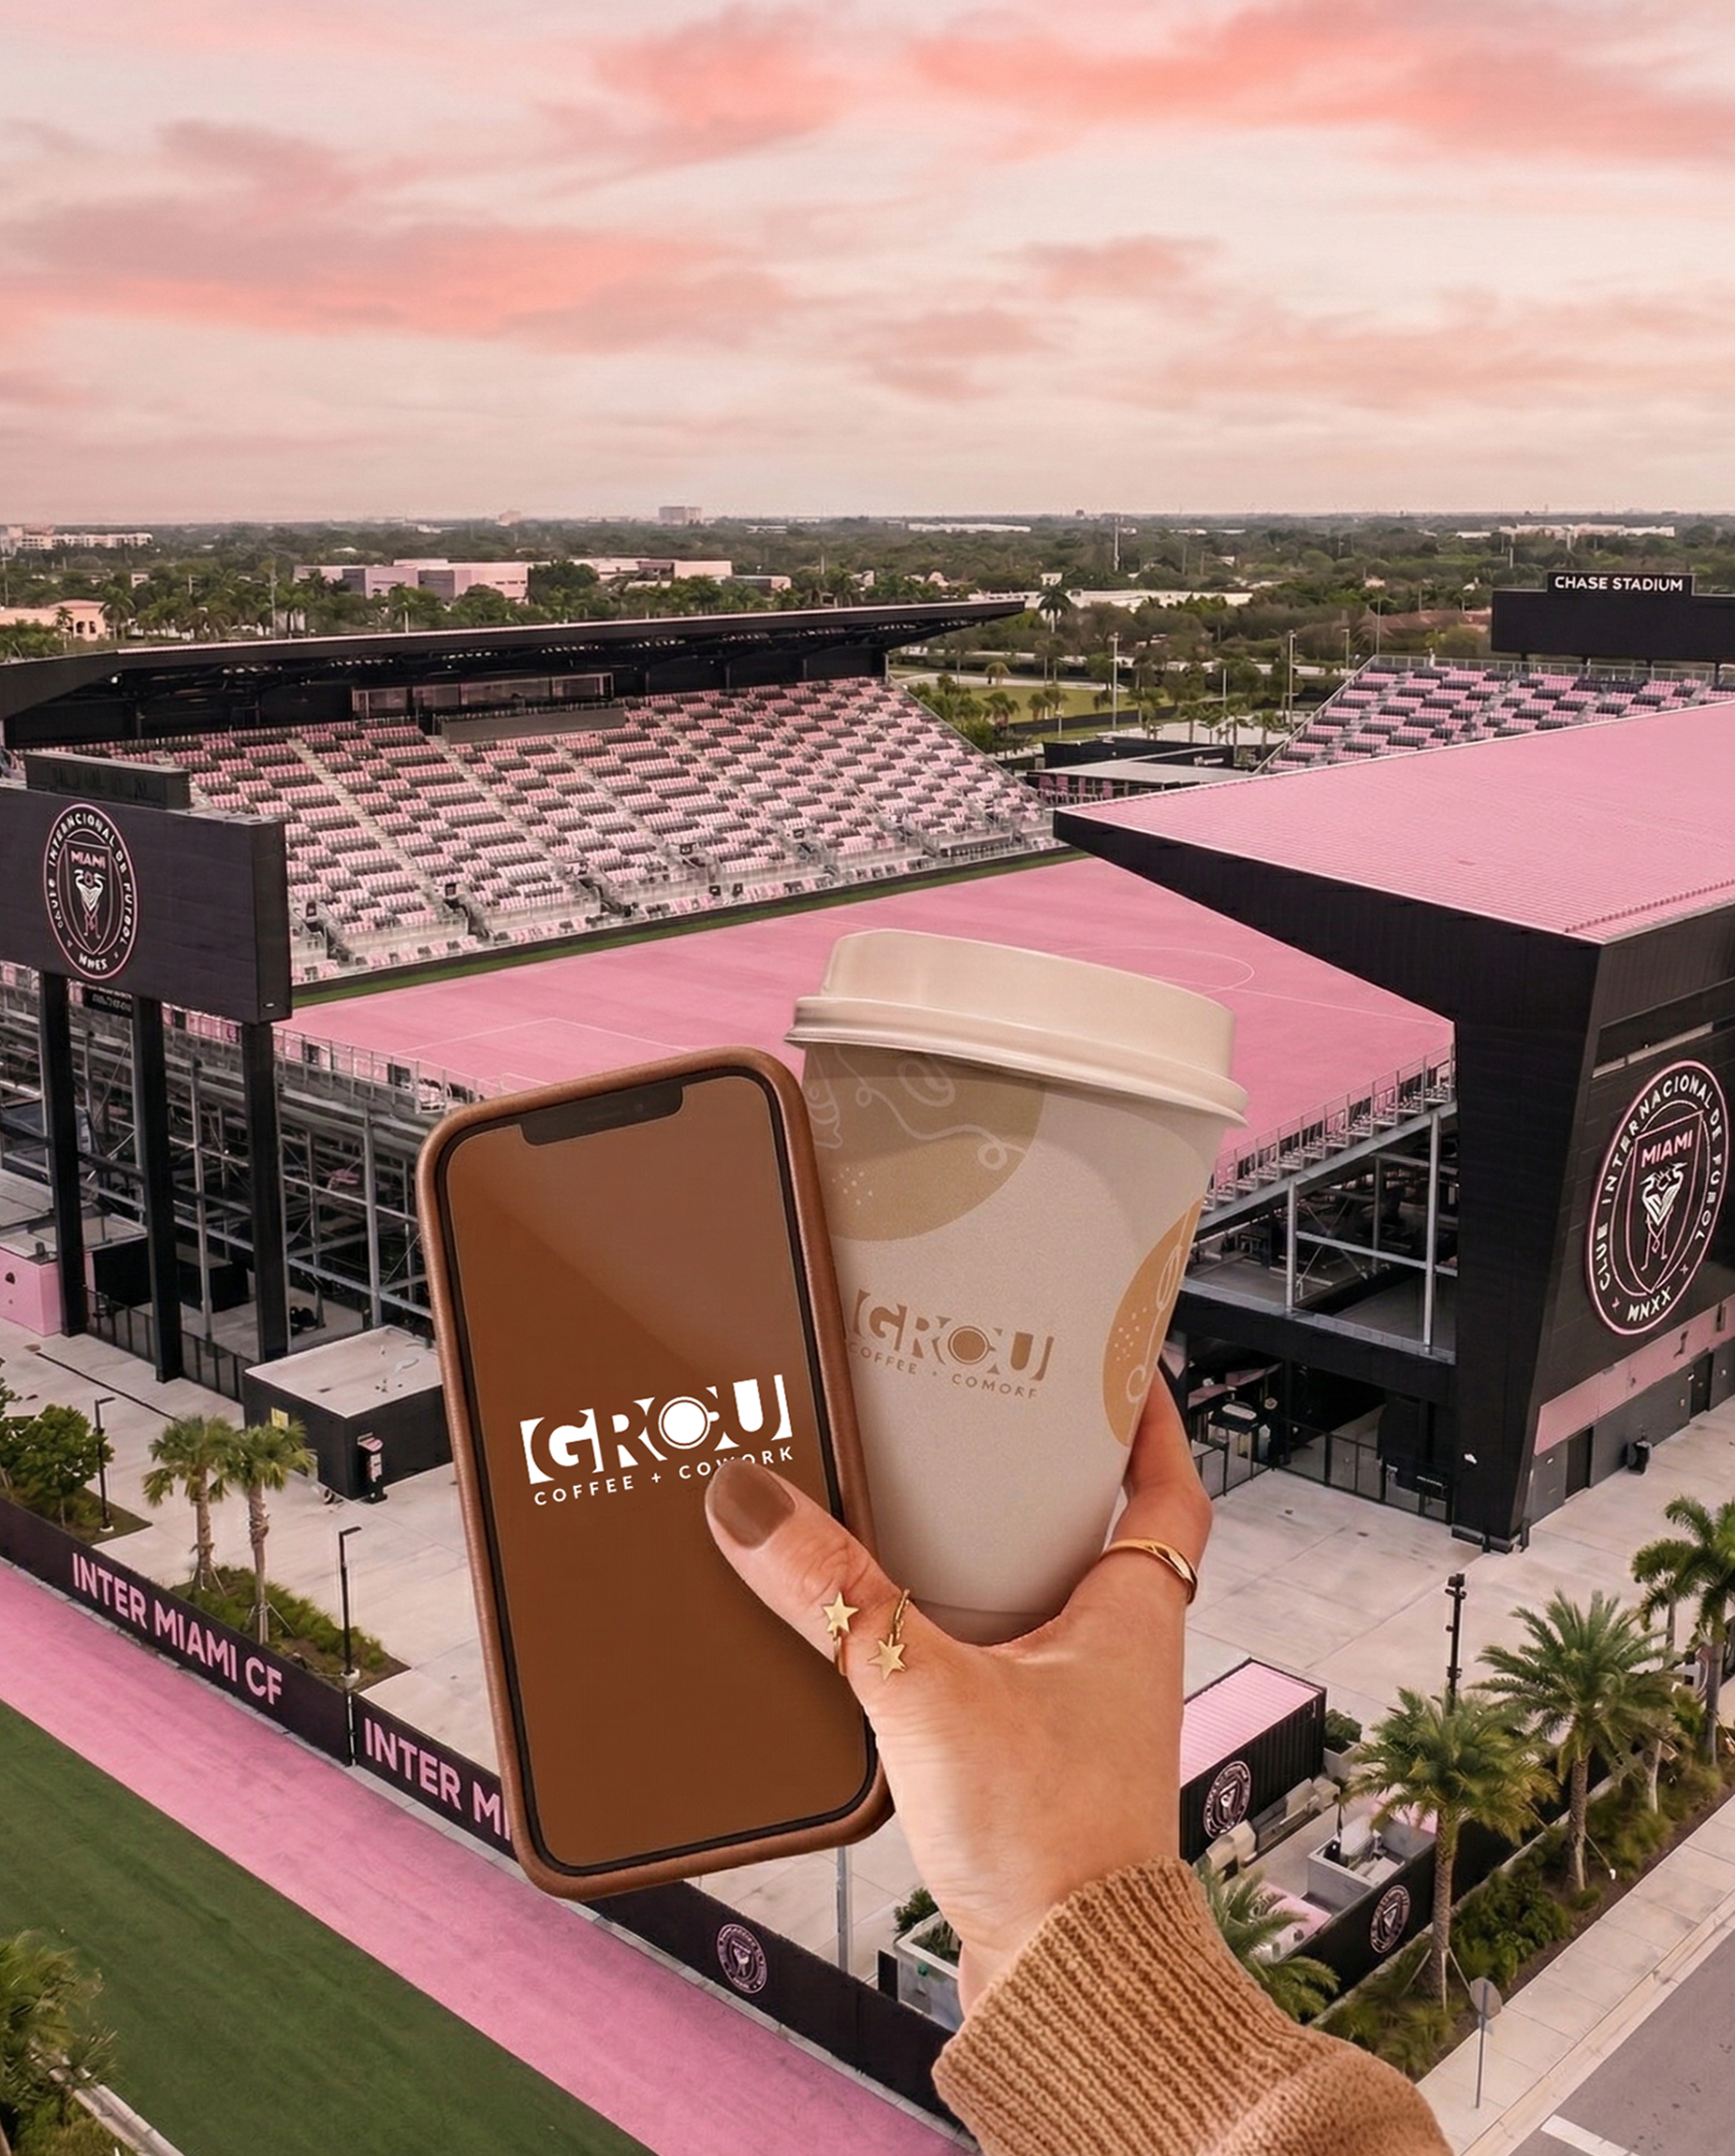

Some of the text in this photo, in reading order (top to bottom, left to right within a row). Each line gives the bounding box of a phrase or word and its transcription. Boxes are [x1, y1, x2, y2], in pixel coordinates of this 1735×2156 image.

[1554, 576, 1684, 591] CHASE STADIUM
[1641, 1129, 1694, 1169] MIAMI
[848, 1341, 917, 1375] COFFEE
[533, 1475, 634, 1506] COFFEE
[72, 1552, 283, 1705] INTER MIAMI CF
[364, 1717, 462, 1812] INTER
